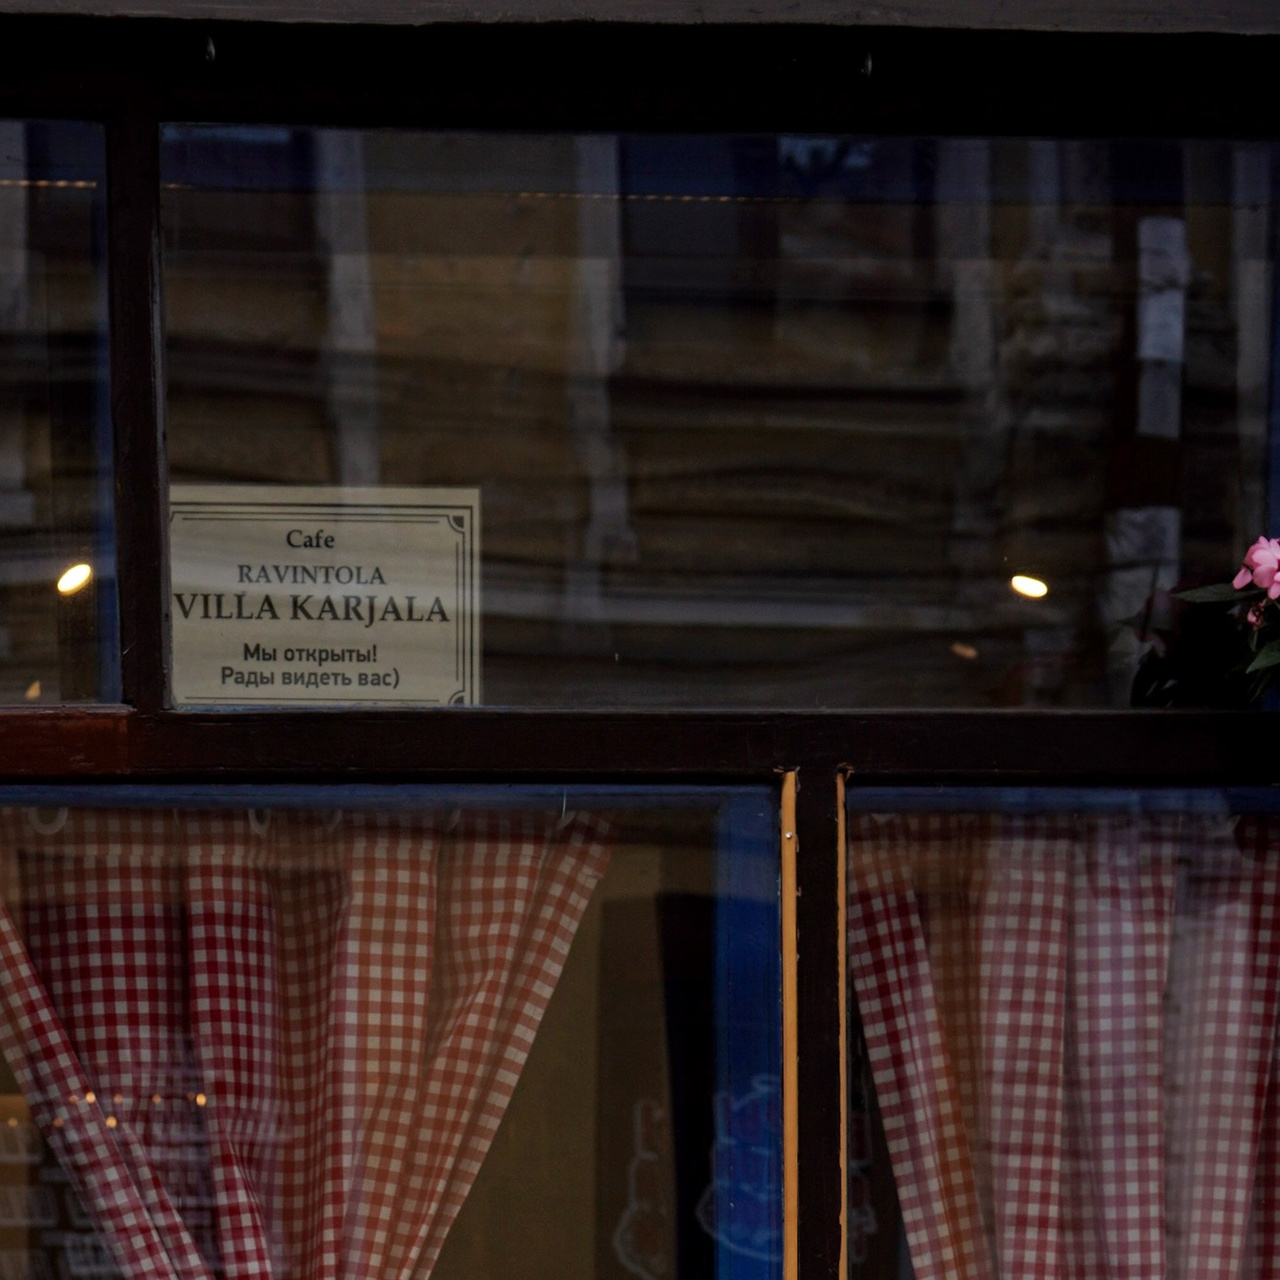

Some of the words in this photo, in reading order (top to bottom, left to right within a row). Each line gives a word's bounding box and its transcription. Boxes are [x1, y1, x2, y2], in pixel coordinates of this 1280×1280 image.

[286, 529, 335, 549] Cafe
[237, 564, 387, 586] RAVINTOLA
[173, 592, 281, 620] VILLA
[289, 594, 451, 628] KARJALA
[243, 643, 277, 662] Мы
[284, 645, 378, 666] открыты!
[221, 666, 275, 687] Рады
[281, 669, 352, 688] видеть
[358, 668, 400, 689] вас)
